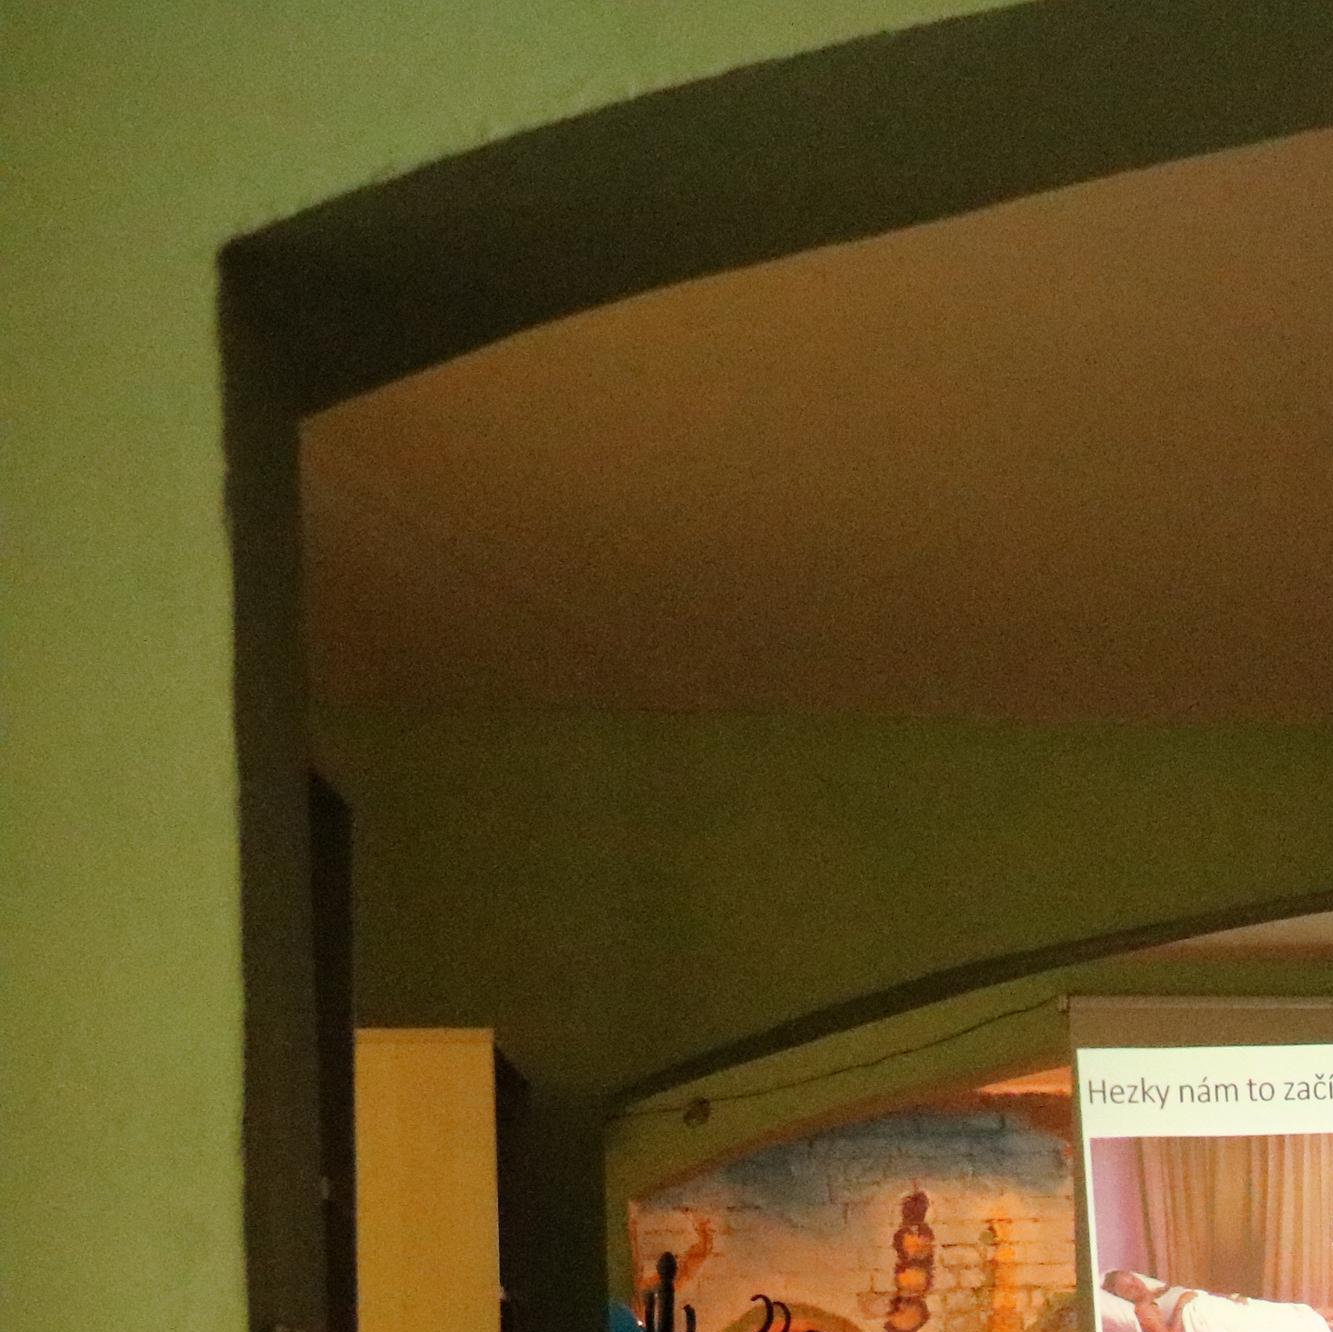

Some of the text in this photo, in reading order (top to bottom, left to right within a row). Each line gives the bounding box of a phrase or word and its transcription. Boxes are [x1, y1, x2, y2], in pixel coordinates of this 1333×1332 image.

[1088, 1076, 1171, 1110] Hezky
[1178, 1076, 1239, 1104] nám
[1247, 1078, 1276, 1102] to
